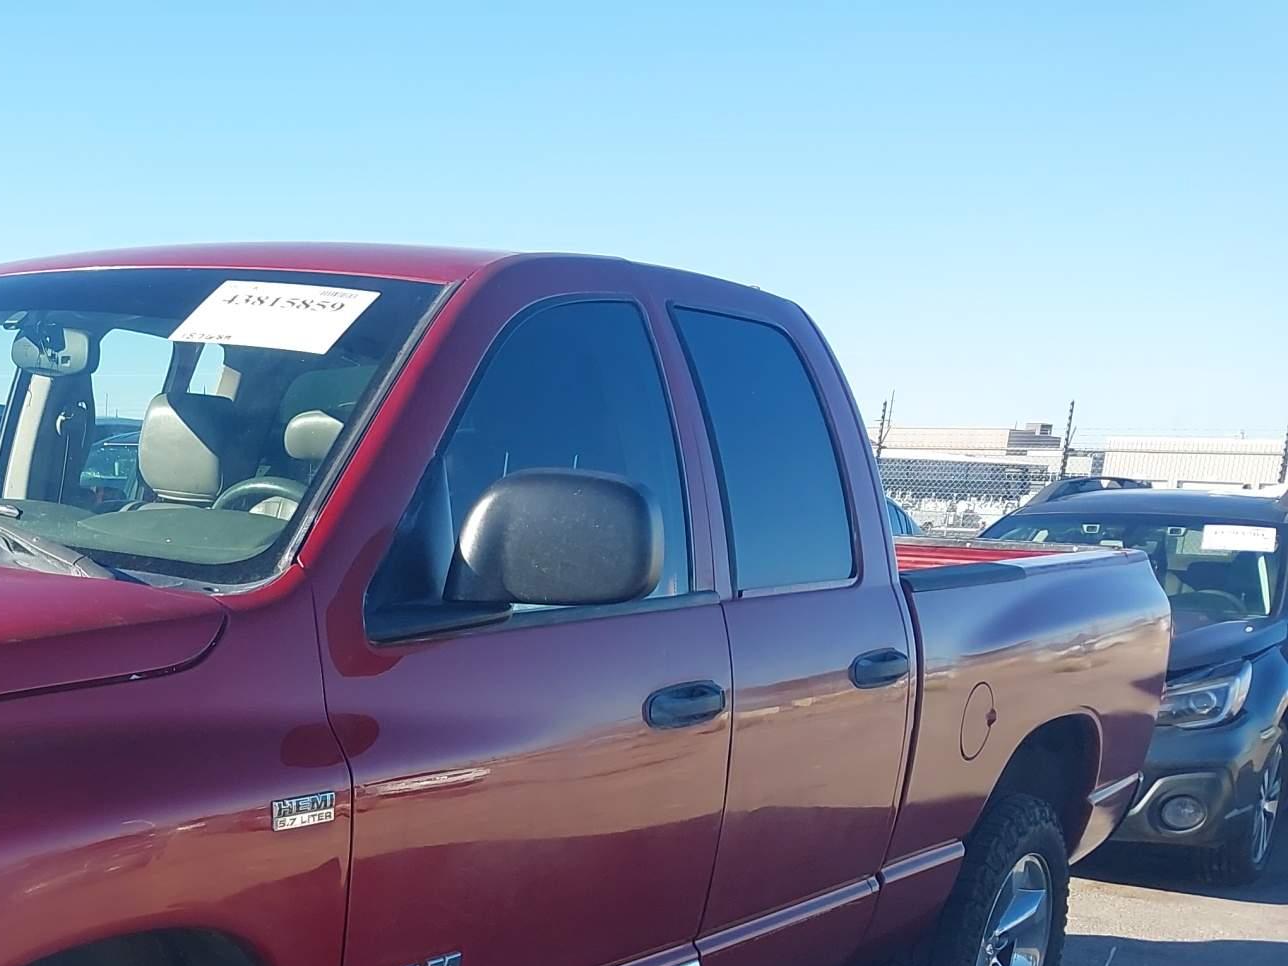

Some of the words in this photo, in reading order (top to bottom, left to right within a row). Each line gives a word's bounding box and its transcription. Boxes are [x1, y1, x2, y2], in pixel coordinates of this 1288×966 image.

[222, 293, 345, 312] 43815859
[278, 817, 297, 829] 5.7
[300, 811, 333, 825] LITER
